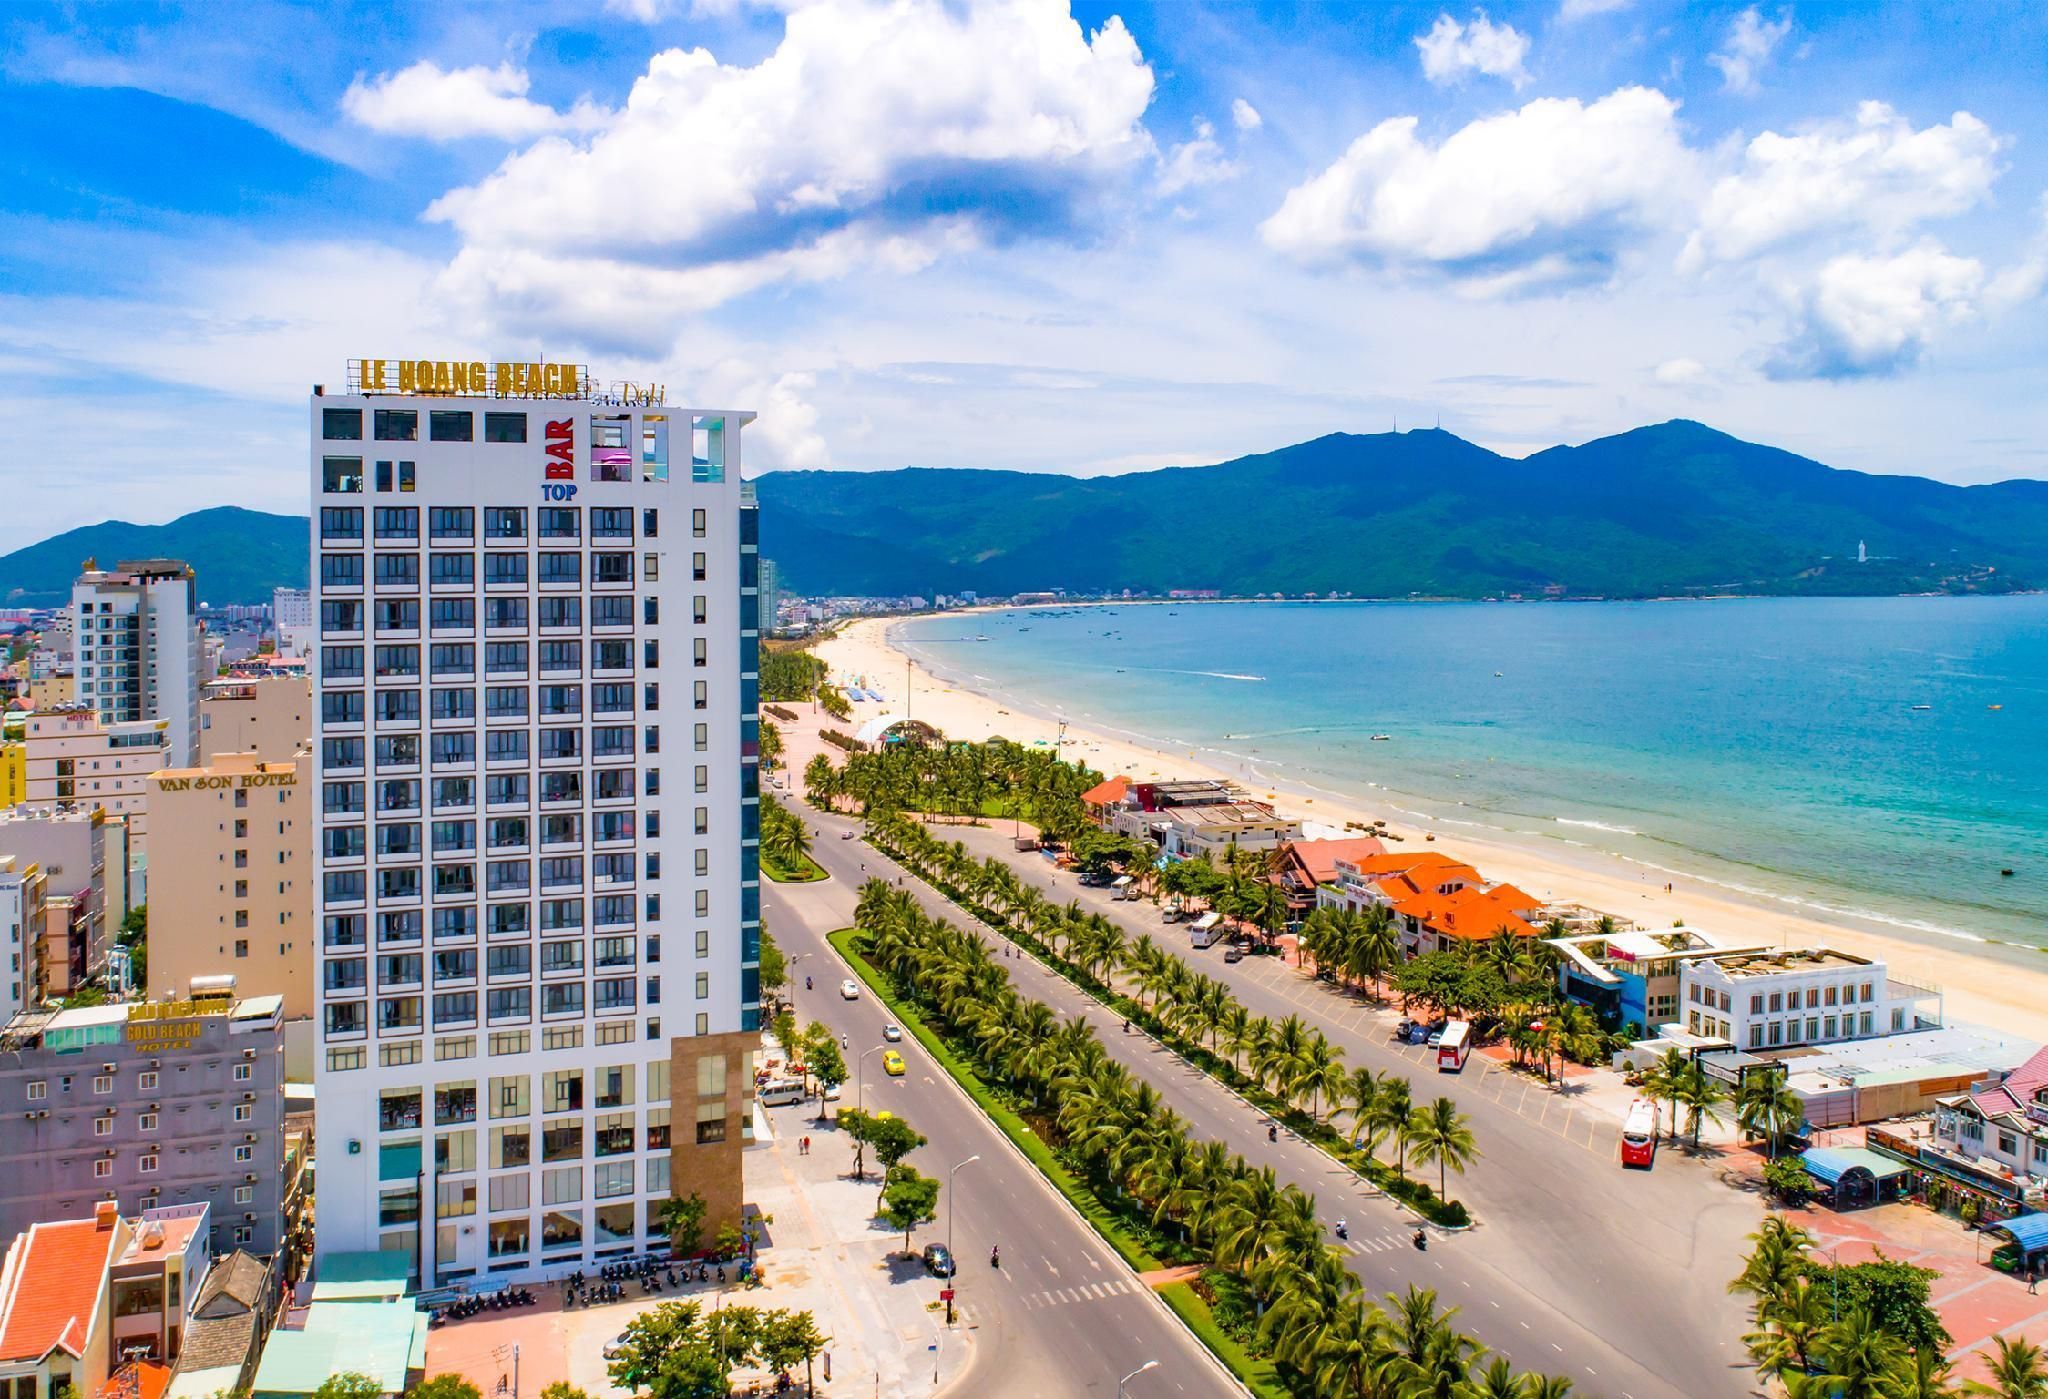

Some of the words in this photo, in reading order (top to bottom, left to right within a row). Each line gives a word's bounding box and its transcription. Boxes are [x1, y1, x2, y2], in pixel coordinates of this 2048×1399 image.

[360, 359, 386, 390] LE
[399, 360, 487, 393] HOANG
[495, 362, 577, 394] BEACH
[545, 417, 573, 480] BAR
[541, 484, 578, 501] TOP
[159, 778, 190, 791] VAN
[194, 775, 233, 790] SON
[240, 773, 297, 788] HOTEL
[127, 1025, 156, 1041] GOLD
[160, 1022, 200, 1038] BEACH
[136, 1041, 191, 1052] HOTEL
